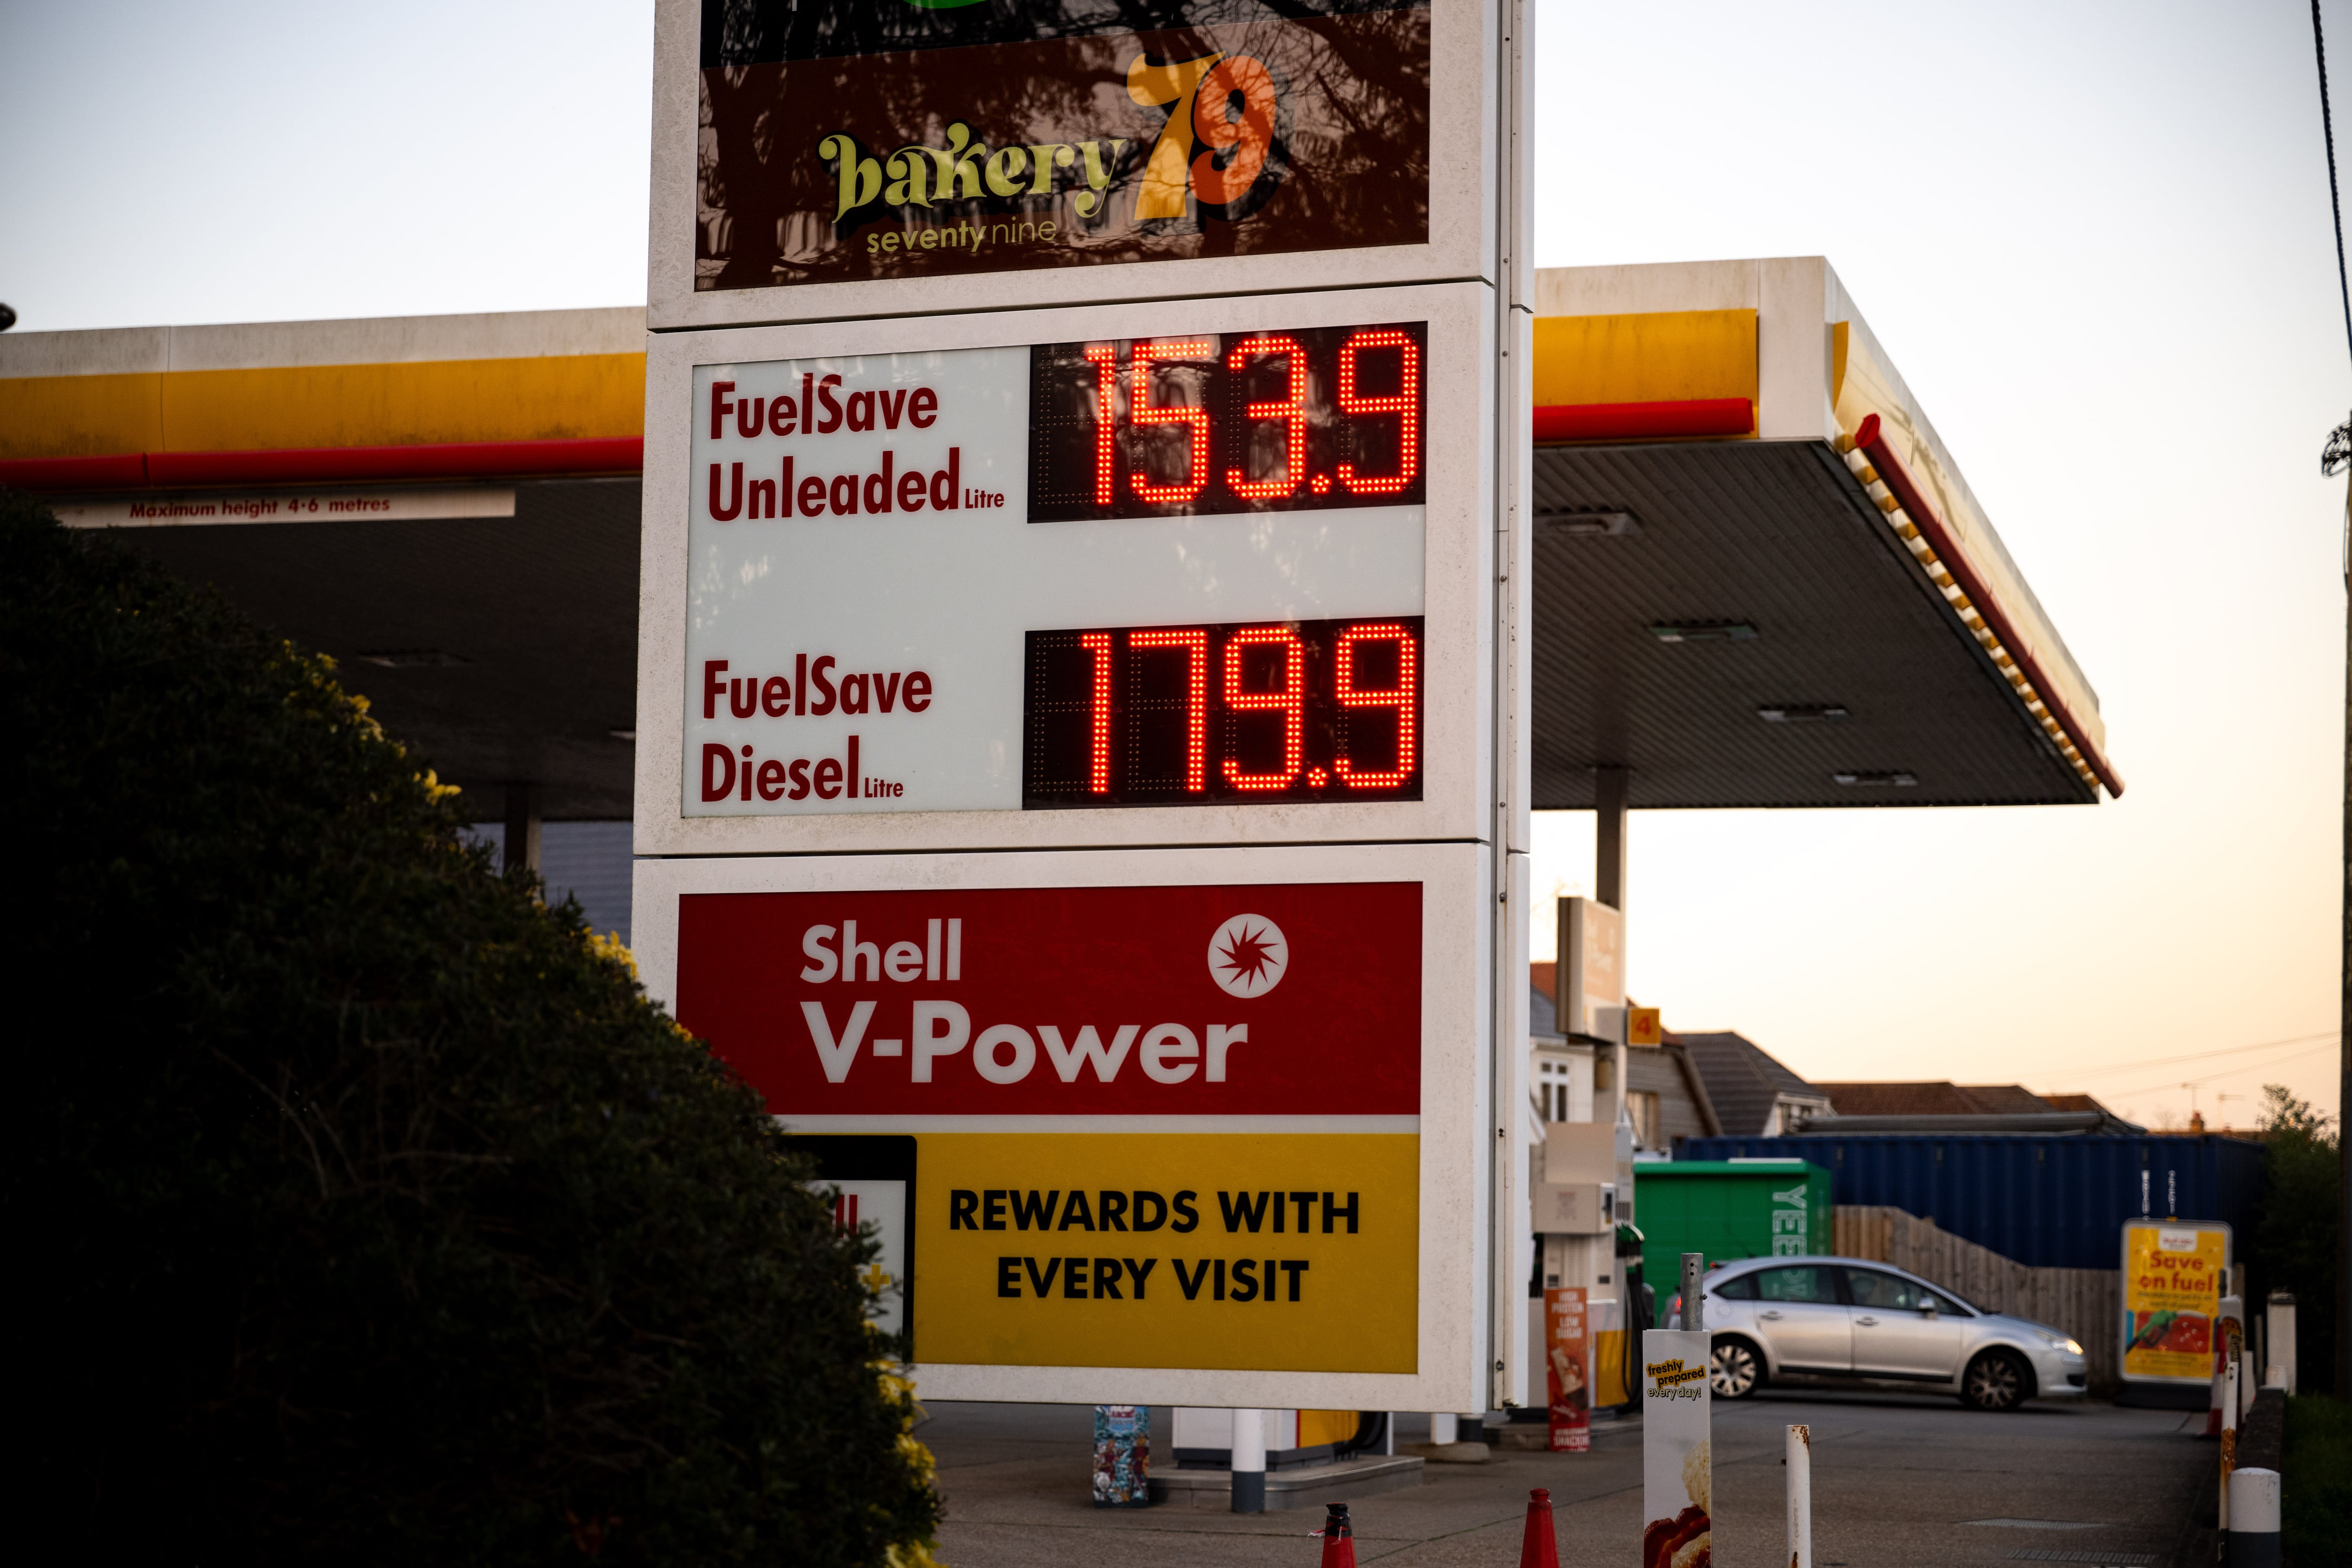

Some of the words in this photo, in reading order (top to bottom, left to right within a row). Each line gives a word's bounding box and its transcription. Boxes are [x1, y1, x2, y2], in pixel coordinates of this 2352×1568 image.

[819, 123, 1127, 223] bakery
[1127, 51, 1275, 221] 79
[866, 219, 987, 253] seventy
[992, 216, 1057, 243] nine
[710, 373, 938, 439] FuelSave
[1085, 332, 1418, 505] 153.9
[709, 447, 960, 522] Unleaded
[965, 488, 1005, 509] Litre
[130, 502, 215, 518] Maximum
[222, 499, 278, 518] height
[329, 497, 390, 512] metres
[703, 653, 932, 719] FuelSave
[1081, 624, 1415, 793] 179.9
[701, 735, 859, 802] Diesel
[865, 777, 903, 798] Litre
[800, 918, 961, 983] Shell
[800, 1000, 1248, 1084] V-Power
[1636, 1016, 1651, 1035] 4
[950, 1189, 1199, 1233] REWARDS
[1217, 1191, 1359, 1234] WITH
[997, 1257, 1158, 1299] EVERY
[1171, 1259, 1309, 1302] VISIT
[2138, 1275, 2166, 1289] on
[2172, 1271, 2214, 1292] fuel
[2150, 1250, 2204, 1271] Save
[1648, 1361, 1682, 1376] freshly
[1657, 1367, 1704, 1388] prepared
[1647, 1388, 1677, 1401] every
[1677, 1386, 1701, 1401] day!
